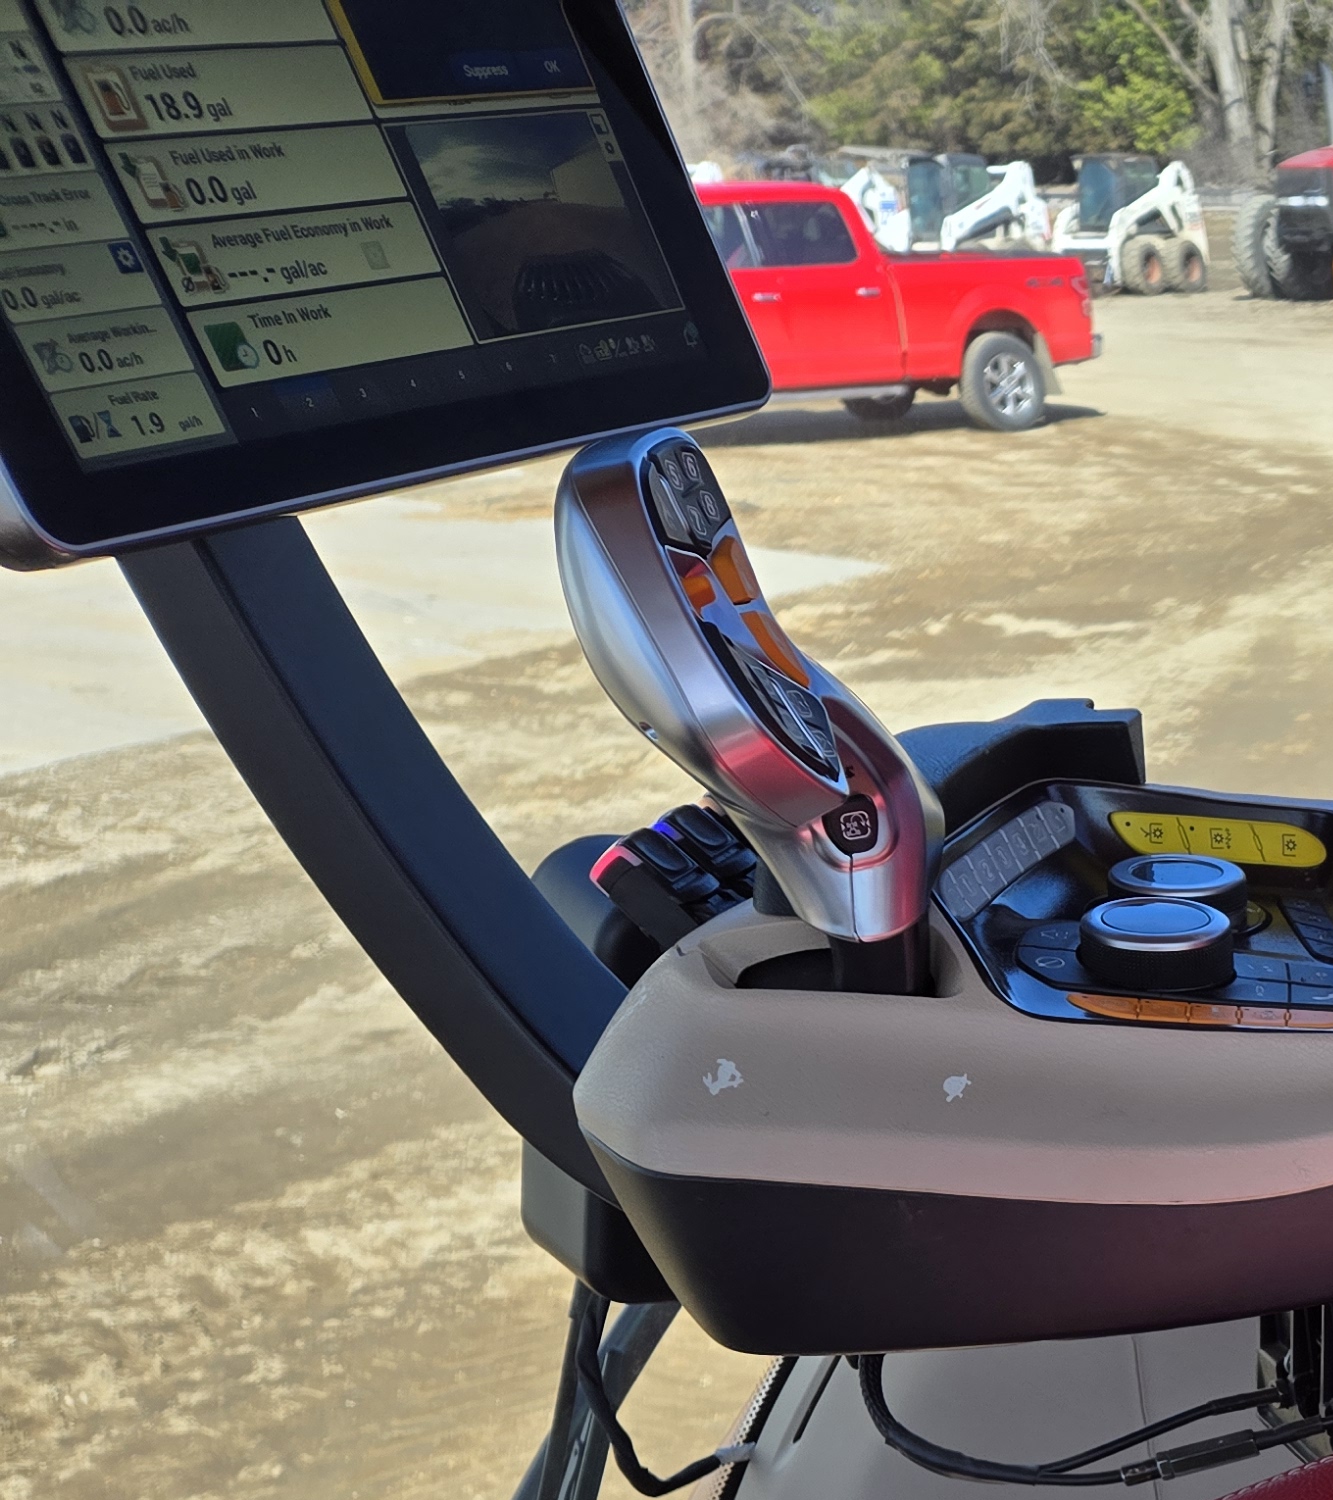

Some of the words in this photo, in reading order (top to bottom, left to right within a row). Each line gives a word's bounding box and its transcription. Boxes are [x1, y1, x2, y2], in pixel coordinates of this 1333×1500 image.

[104, 5, 148, 36] 0.0
[152, 13, 190, 34] ac/h
[129, 65, 160, 81] Fuel
[162, 62, 197, 79] Used
[462, 64, 509, 80] Suppress
[543, 60, 561, 74] OK
[144, 91, 204, 122] 18.9
[207, 98, 233, 123] gal
[169, 149, 200, 166] Fuel
[203, 146, 235, 163] Used
[237, 144, 249, 161] in
[250, 142, 284, 159] Work
[185, 175, 228, 205] 0.0
[231, 180, 257, 206] gal
[211, 232, 263, 250] Average
[262, 226, 292, 243] Fuel
[293, 219, 348, 240] Economy
[348, 216, 361, 233] in
[363, 213, 393, 230] Work
[281, 260, 328, 285] gal/ac
[1, 287, 38, 311] 0.0
[247, 312, 283, 329] Time
[283, 310, 298, 325] In
[298, 303, 332, 322] Work
[78, 348, 114, 374] 0.0
[116, 351, 145, 369] ac/h
[262, 338, 282, 366] 0
[283, 344, 298, 364] h
[107, 393, 134, 406] Fuel
[134, 389, 160, 404] Rate
[305, 397, 315, 408] 2
[358, 387, 368, 398] 3
[409, 378, 418, 389] 4
[458, 369, 467, 380] 5
[130, 411, 166, 437] 1.9
[178, 414, 204, 432] gal/h
